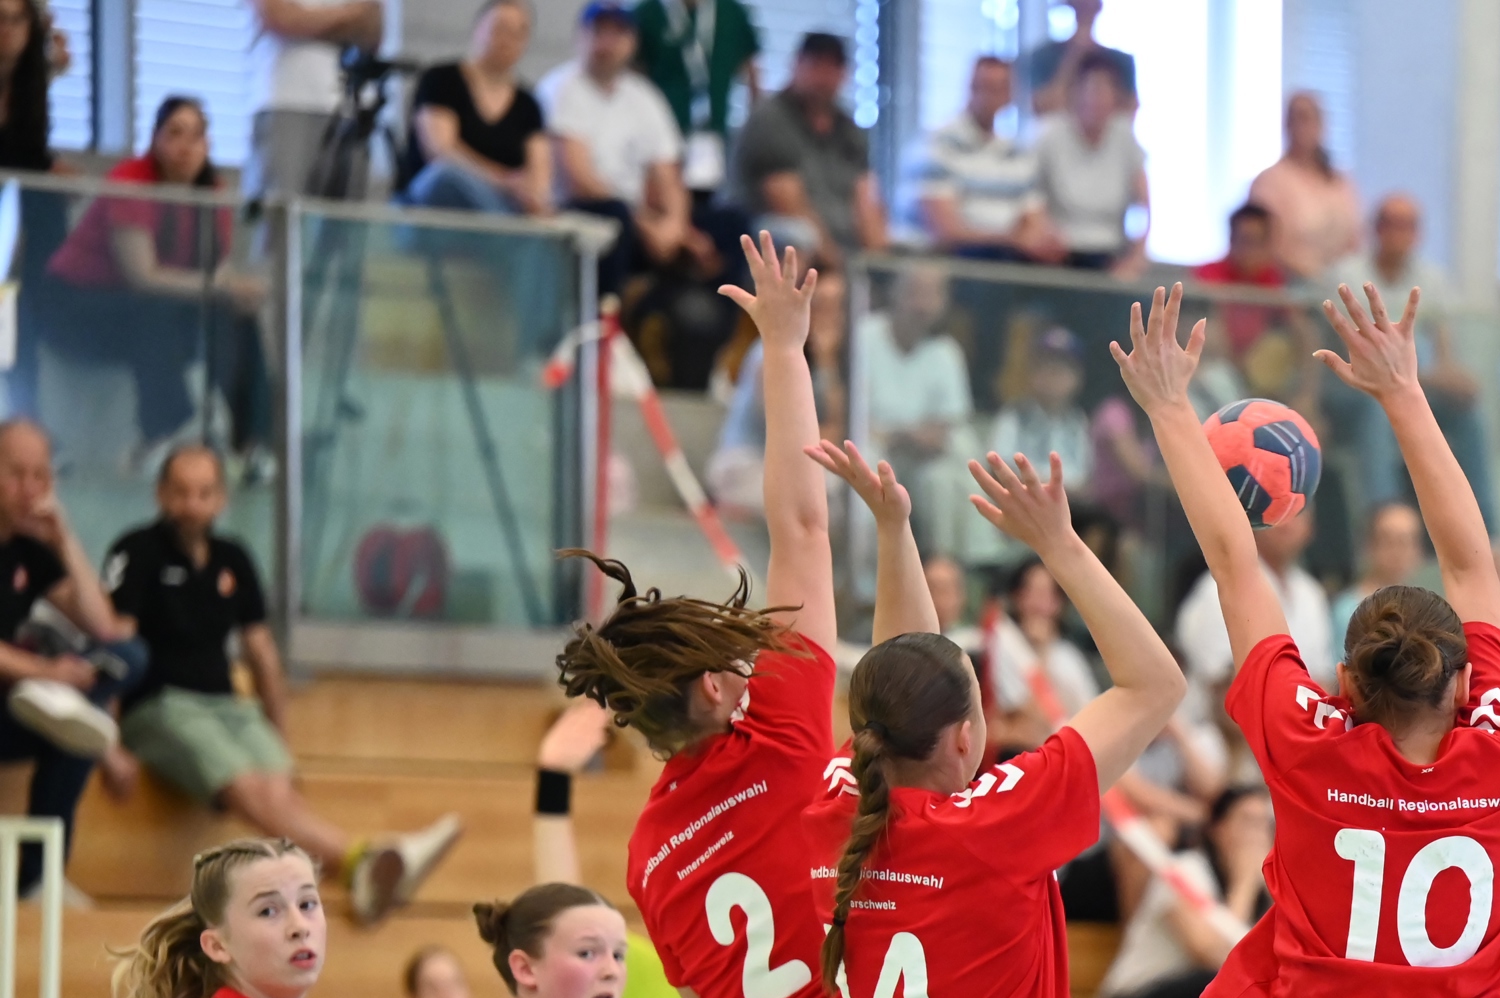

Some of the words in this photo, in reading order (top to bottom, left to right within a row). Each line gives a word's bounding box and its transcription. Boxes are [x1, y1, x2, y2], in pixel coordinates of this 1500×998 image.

[670, 780, 768, 849] Regionalauswahl
[1327, 788, 1394, 810] Handball
[677, 831, 734, 880] Innerschweiz
[1333, 828, 1494, 968] 10
